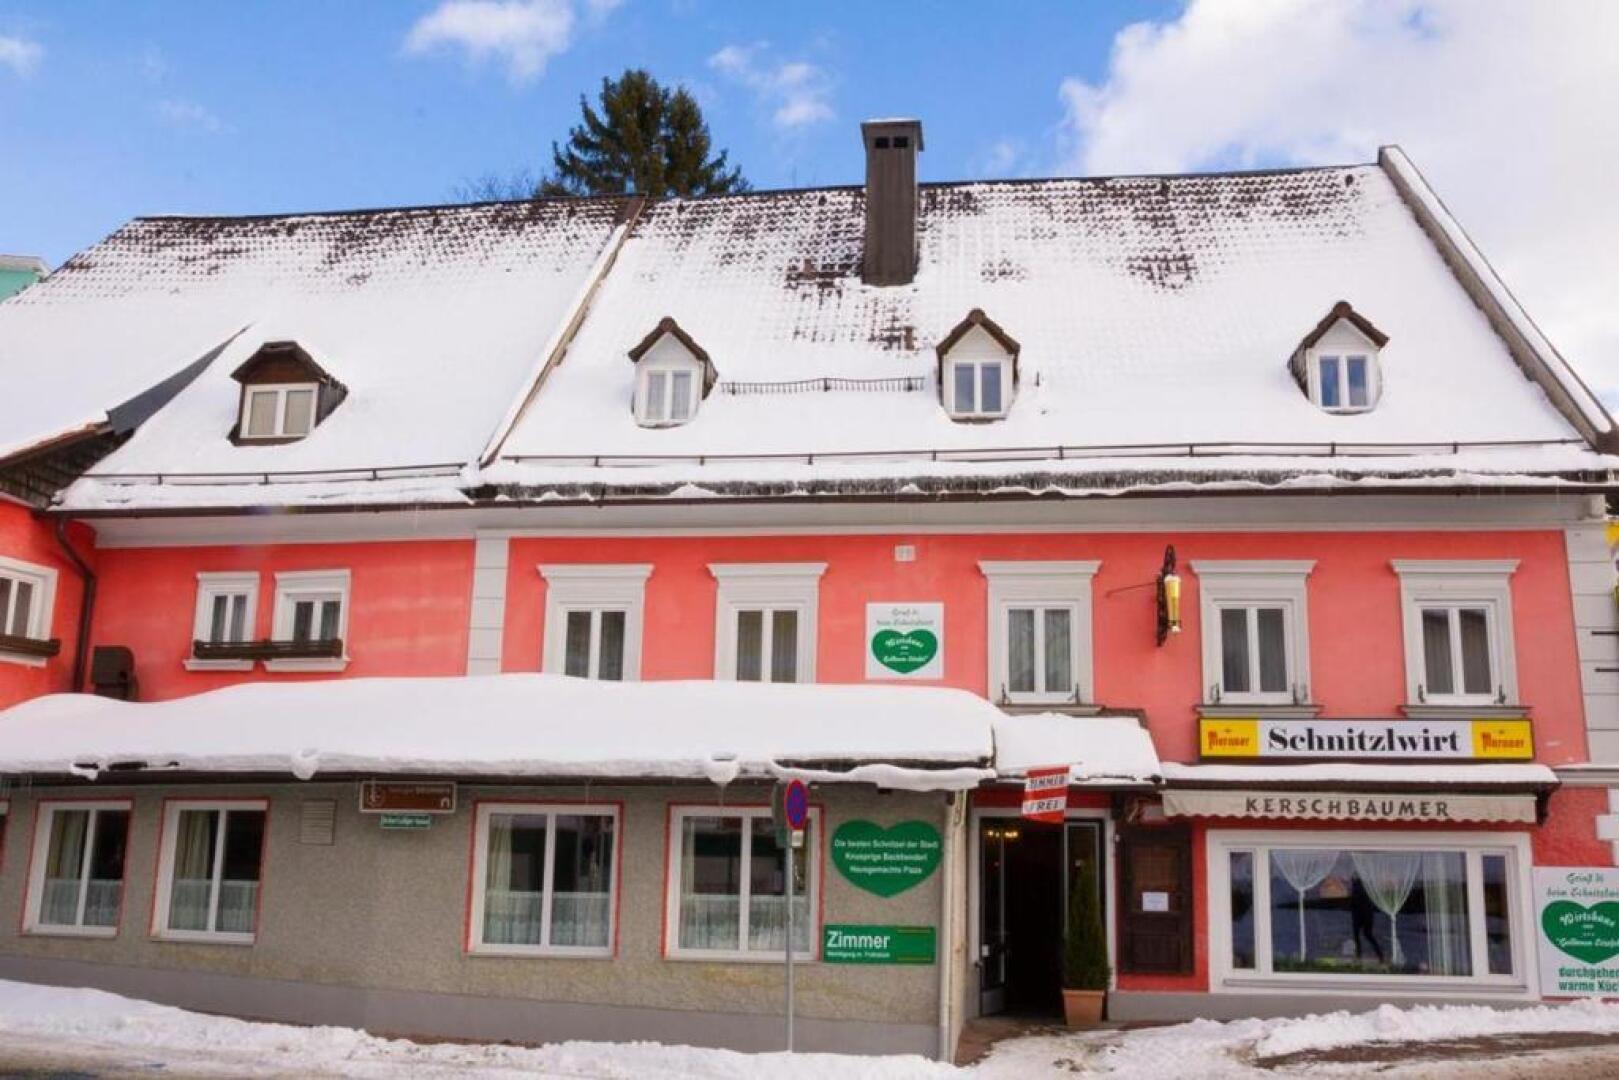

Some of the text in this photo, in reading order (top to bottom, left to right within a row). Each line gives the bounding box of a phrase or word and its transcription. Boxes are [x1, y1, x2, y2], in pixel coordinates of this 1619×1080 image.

[1269, 728, 1459, 751] Schnitzlwirt
[1246, 798, 1449, 816] KERSCHBAUMER
[827, 930, 891, 949] Zimmer
[1559, 981, 1595, 991] warme
